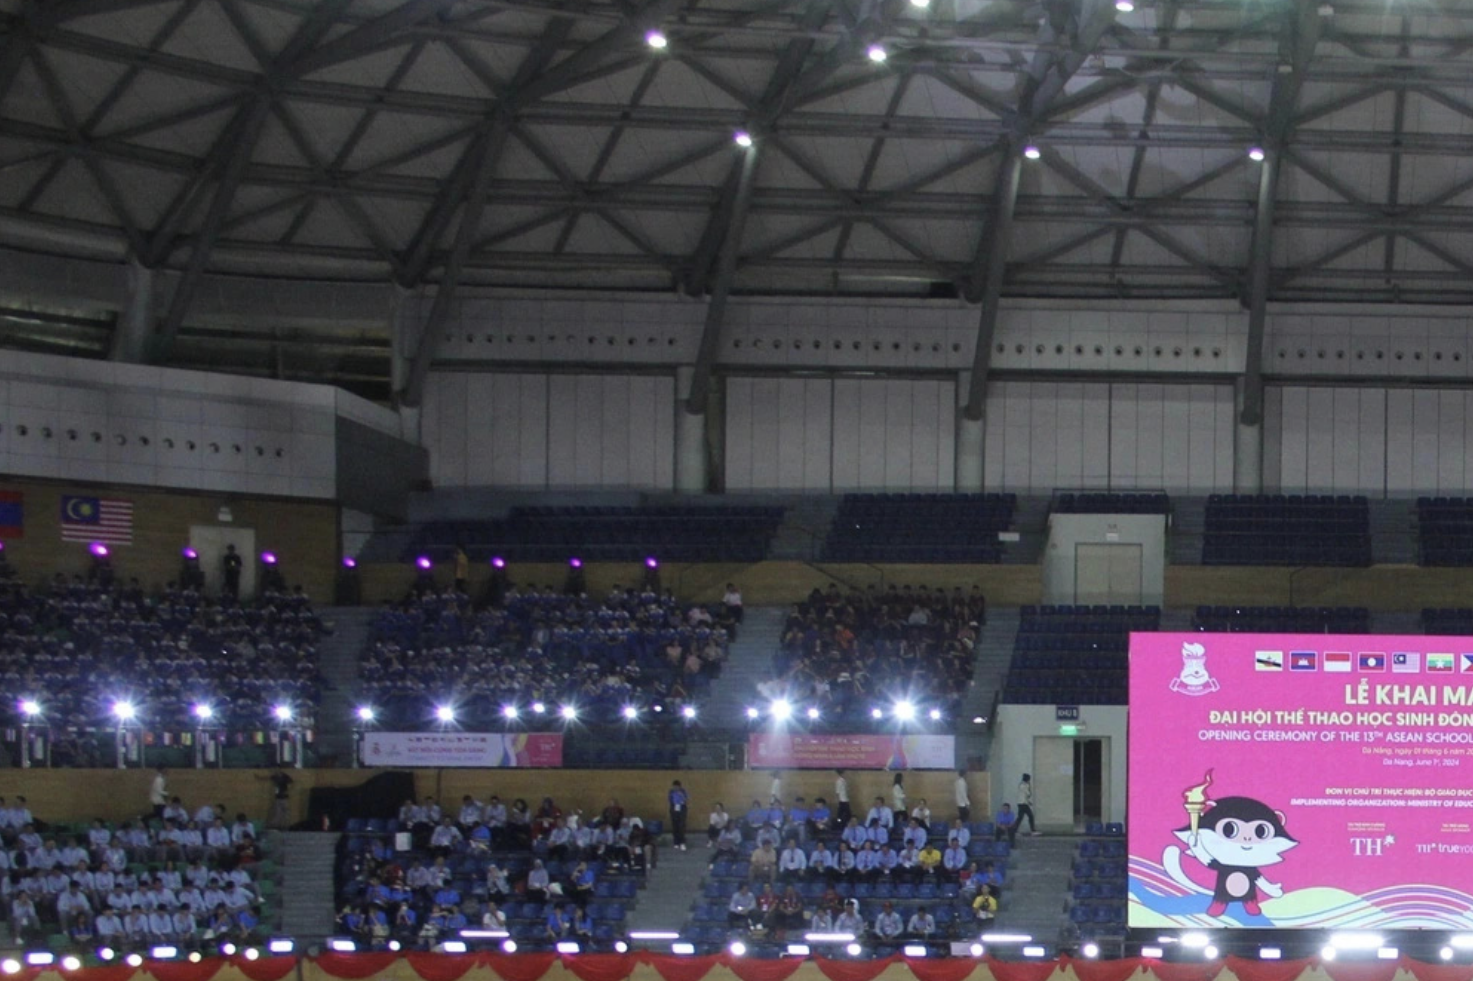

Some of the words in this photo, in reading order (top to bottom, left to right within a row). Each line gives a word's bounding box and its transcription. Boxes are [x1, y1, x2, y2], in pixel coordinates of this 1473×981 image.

[1345, 678, 1369, 706] LỄ
[1376, 684, 1435, 706] KHAI
[1209, 710, 1237, 727] ĐẠI
[1241, 709, 1271, 728] HỘI
[1308, 711, 1353, 726] THAO
[1357, 712, 1393, 729] HỌC
[1396, 712, 1434, 727] SINH
[1198, 729, 1251, 741] OPENING
[1253, 730, 1318, 742] CEREMONY
[1320, 731, 1337, 742] OF
[1340, 731, 1360, 742] THE
[1385, 732, 1423, 743] ASEAN
[1416, 758, 1432, 766] June
[1290, 798, 1346, 806] IMPLEMENTING
[1407, 799, 1442, 807] MINISTRY
[1350, 837, 1383, 856] TH
